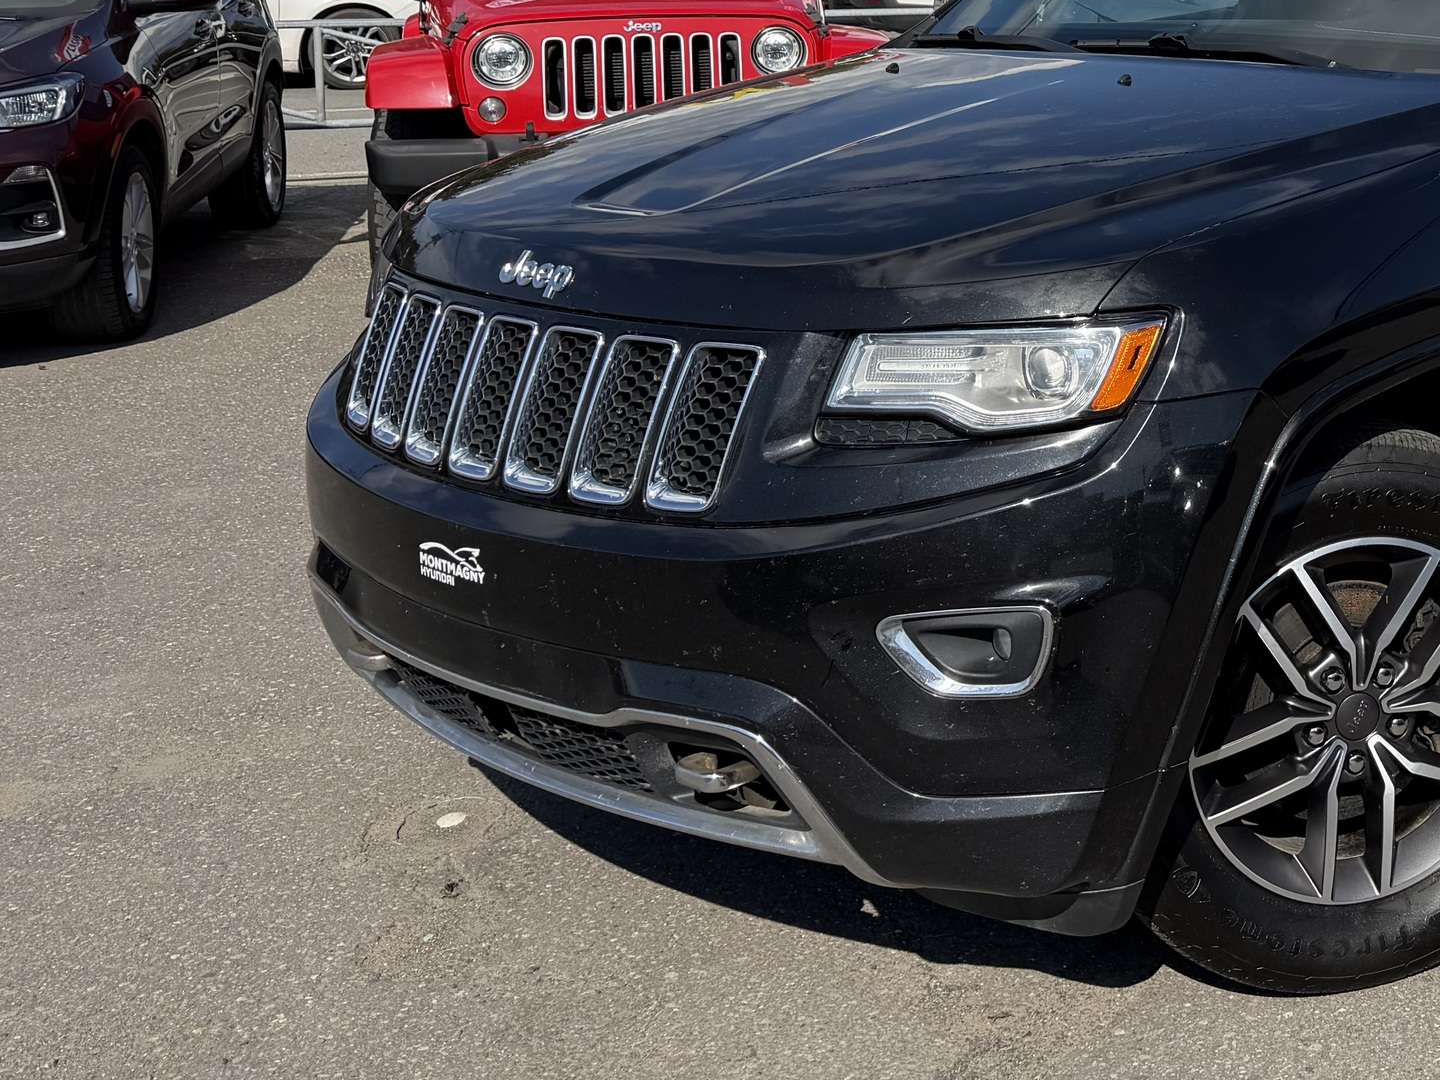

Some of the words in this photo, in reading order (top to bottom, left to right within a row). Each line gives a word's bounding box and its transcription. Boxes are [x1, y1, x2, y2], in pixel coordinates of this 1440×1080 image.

[623, 20, 662, 33] Jeep
[499, 249, 576, 300] Jeep
[419, 551, 486, 585] MONTMAGNY
[420, 564, 455, 587] HYUNDAI
